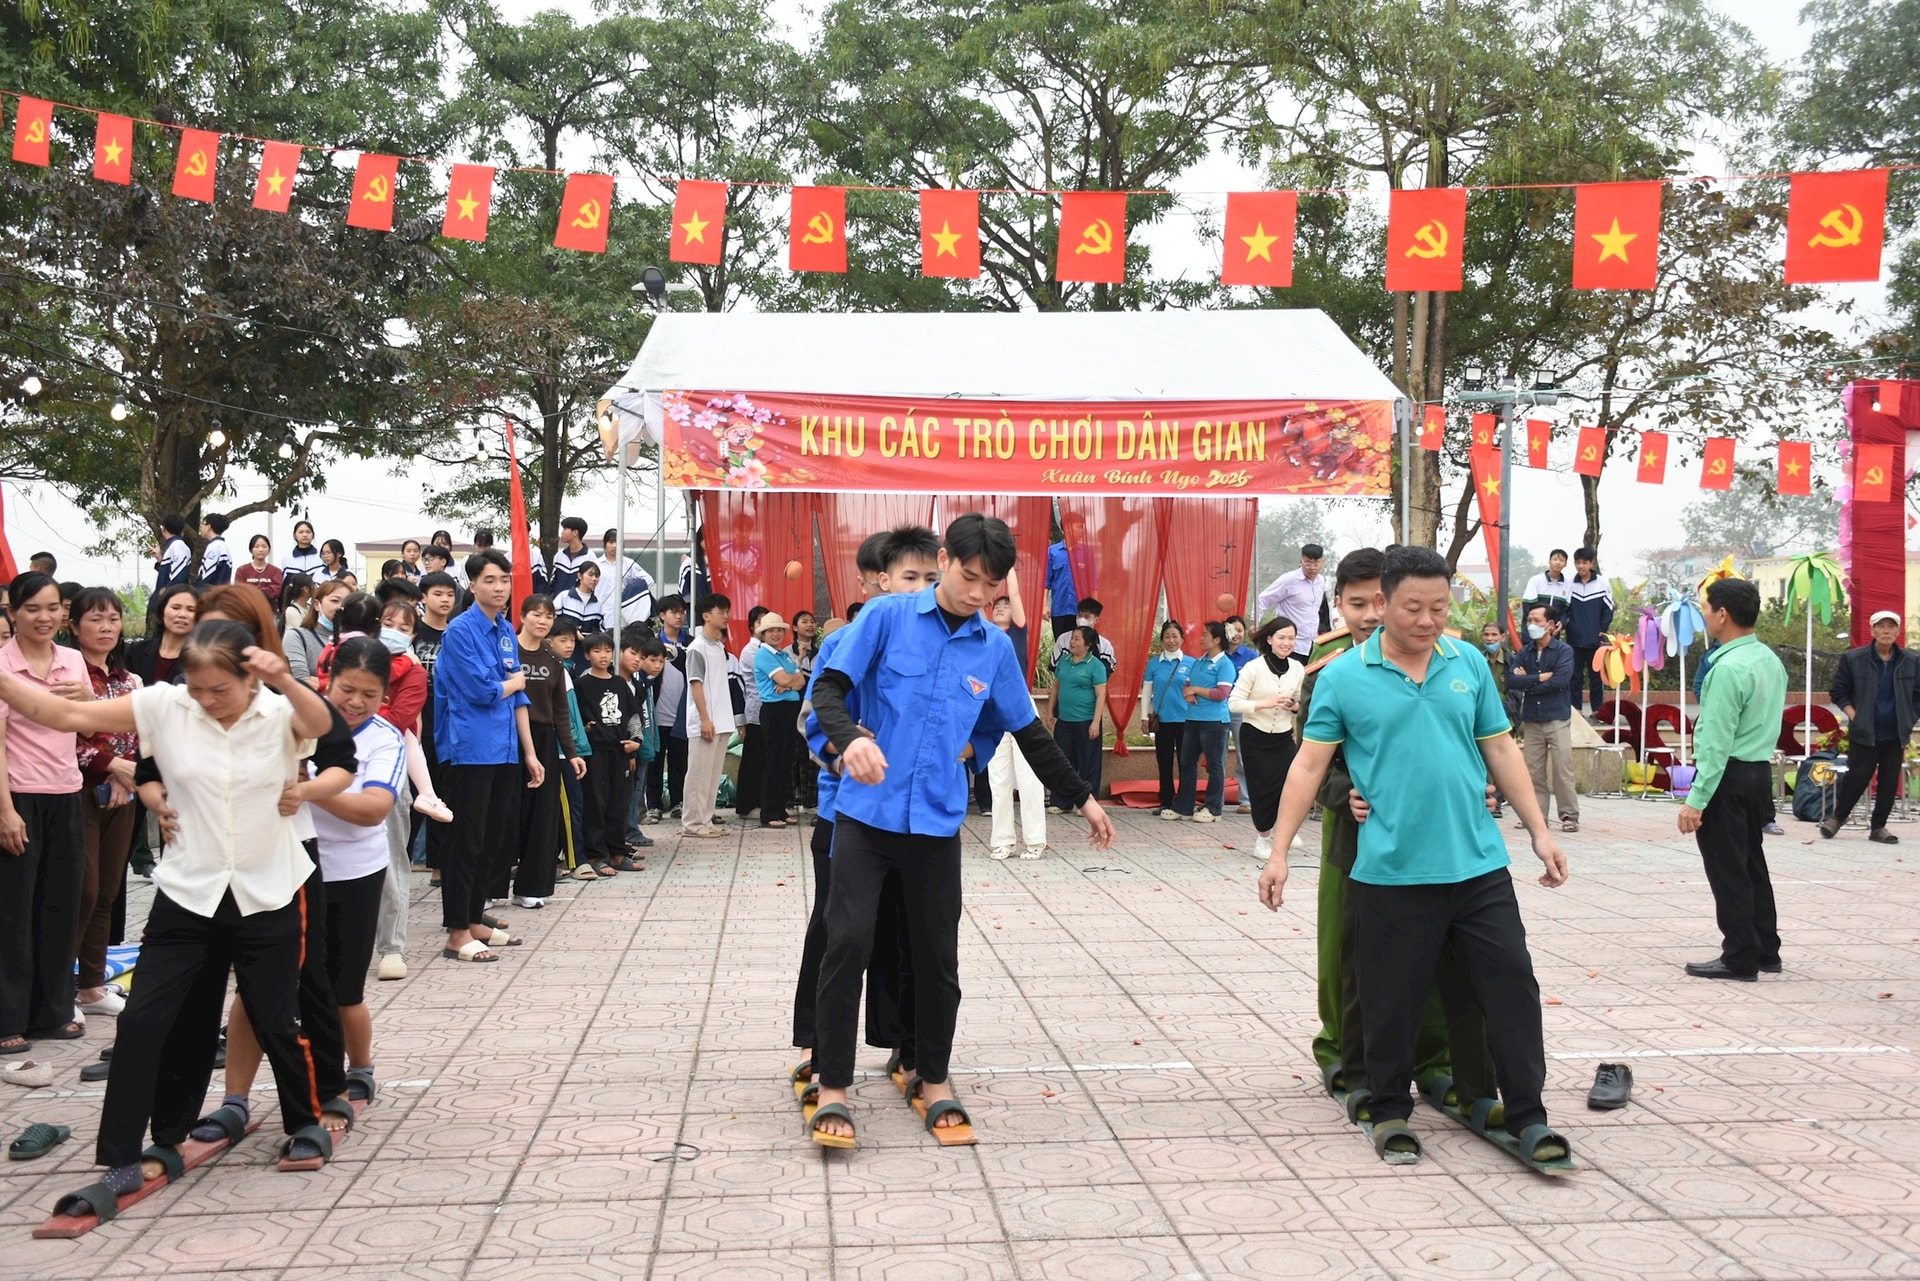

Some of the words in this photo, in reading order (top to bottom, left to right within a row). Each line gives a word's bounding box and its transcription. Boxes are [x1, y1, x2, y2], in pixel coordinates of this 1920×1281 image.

[800, 415, 865, 458] KHU
[879, 407, 941, 459] CÁC
[953, 409, 1016, 460] TRÒ
[1028, 413, 1103, 460] CHƠI
[1116, 410, 1179, 461] DÂN
[1192, 421, 1266, 462] GIAN
[1041, 468, 1097, 484] Xuân
[1103, 469, 1153, 485] Bính
[1160, 470, 1200, 490] Ngọ
[1205, 469, 1255, 489] 2026
[520, 663, 550, 677] OLO
